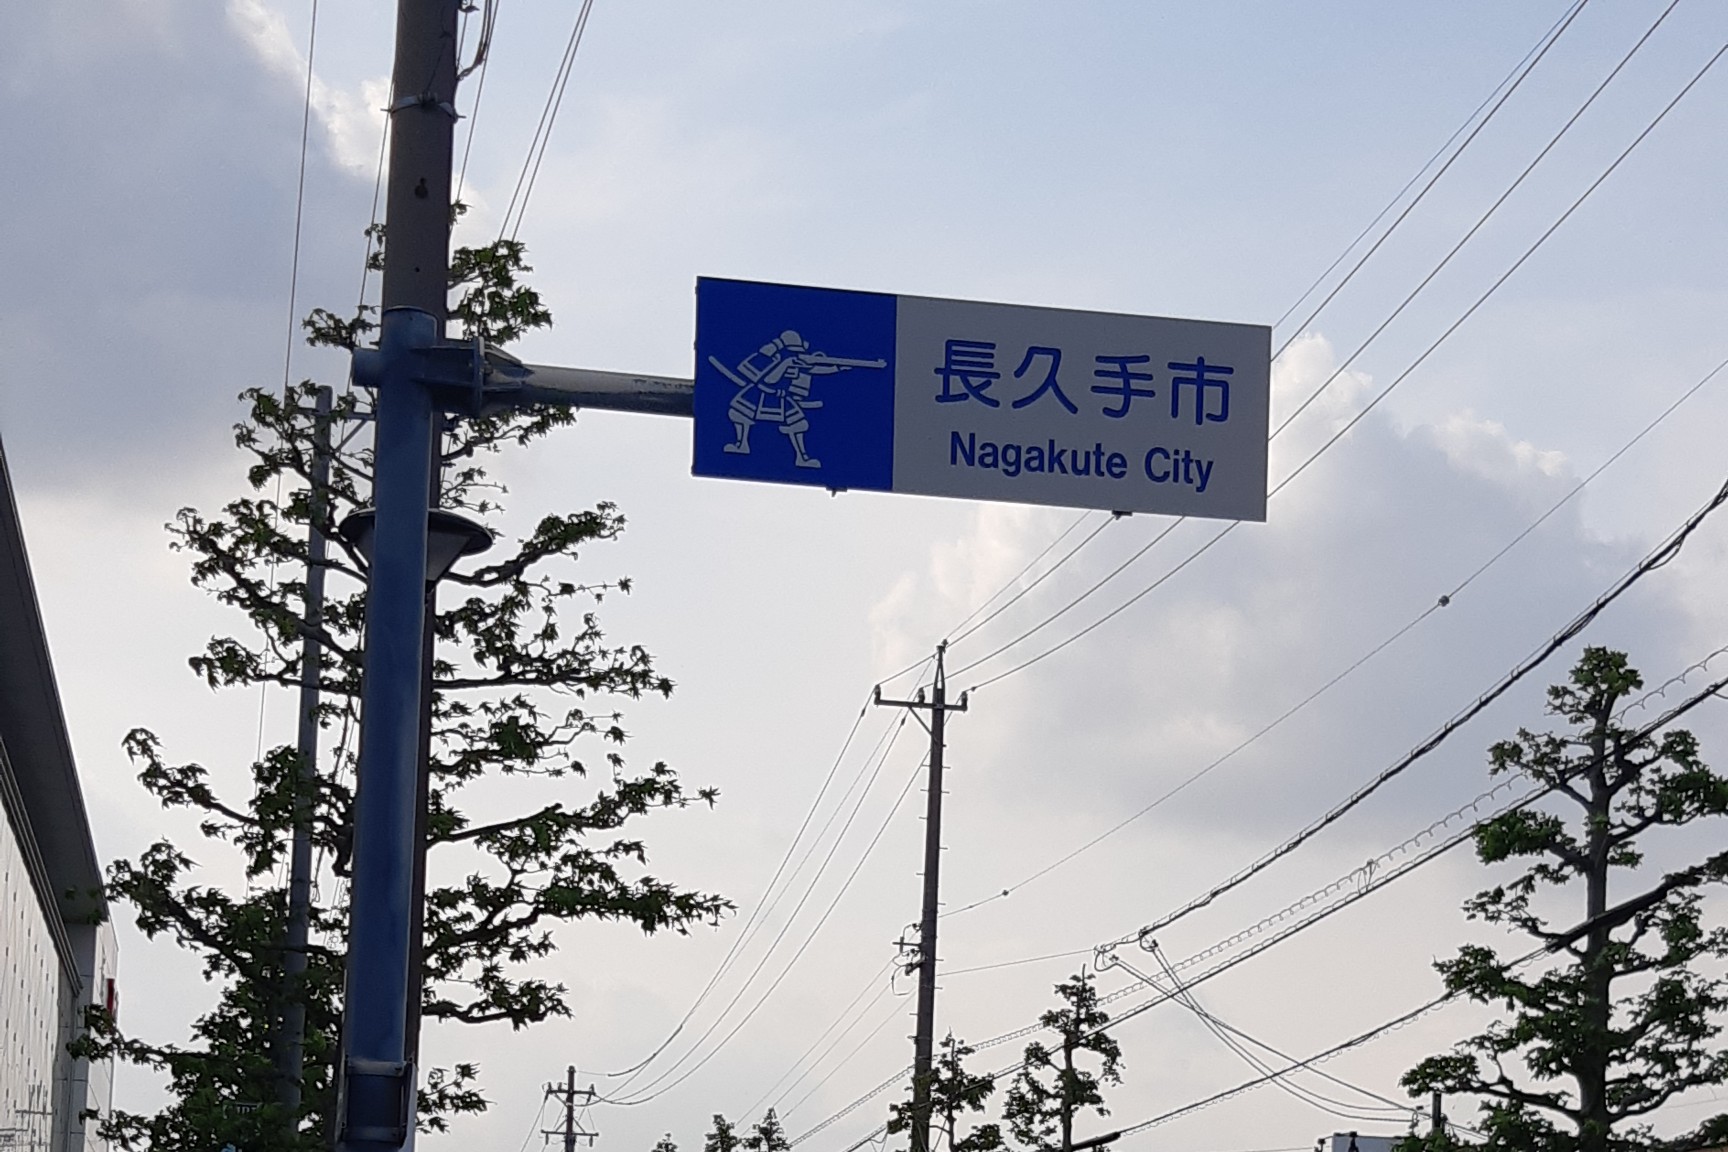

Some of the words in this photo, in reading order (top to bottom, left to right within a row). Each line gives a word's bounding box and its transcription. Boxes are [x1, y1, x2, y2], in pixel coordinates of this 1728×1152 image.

[934, 338, 1235, 426] 長久手市
[949, 431, 1128, 479] Nagakute
[1143, 446, 1214, 492] City
